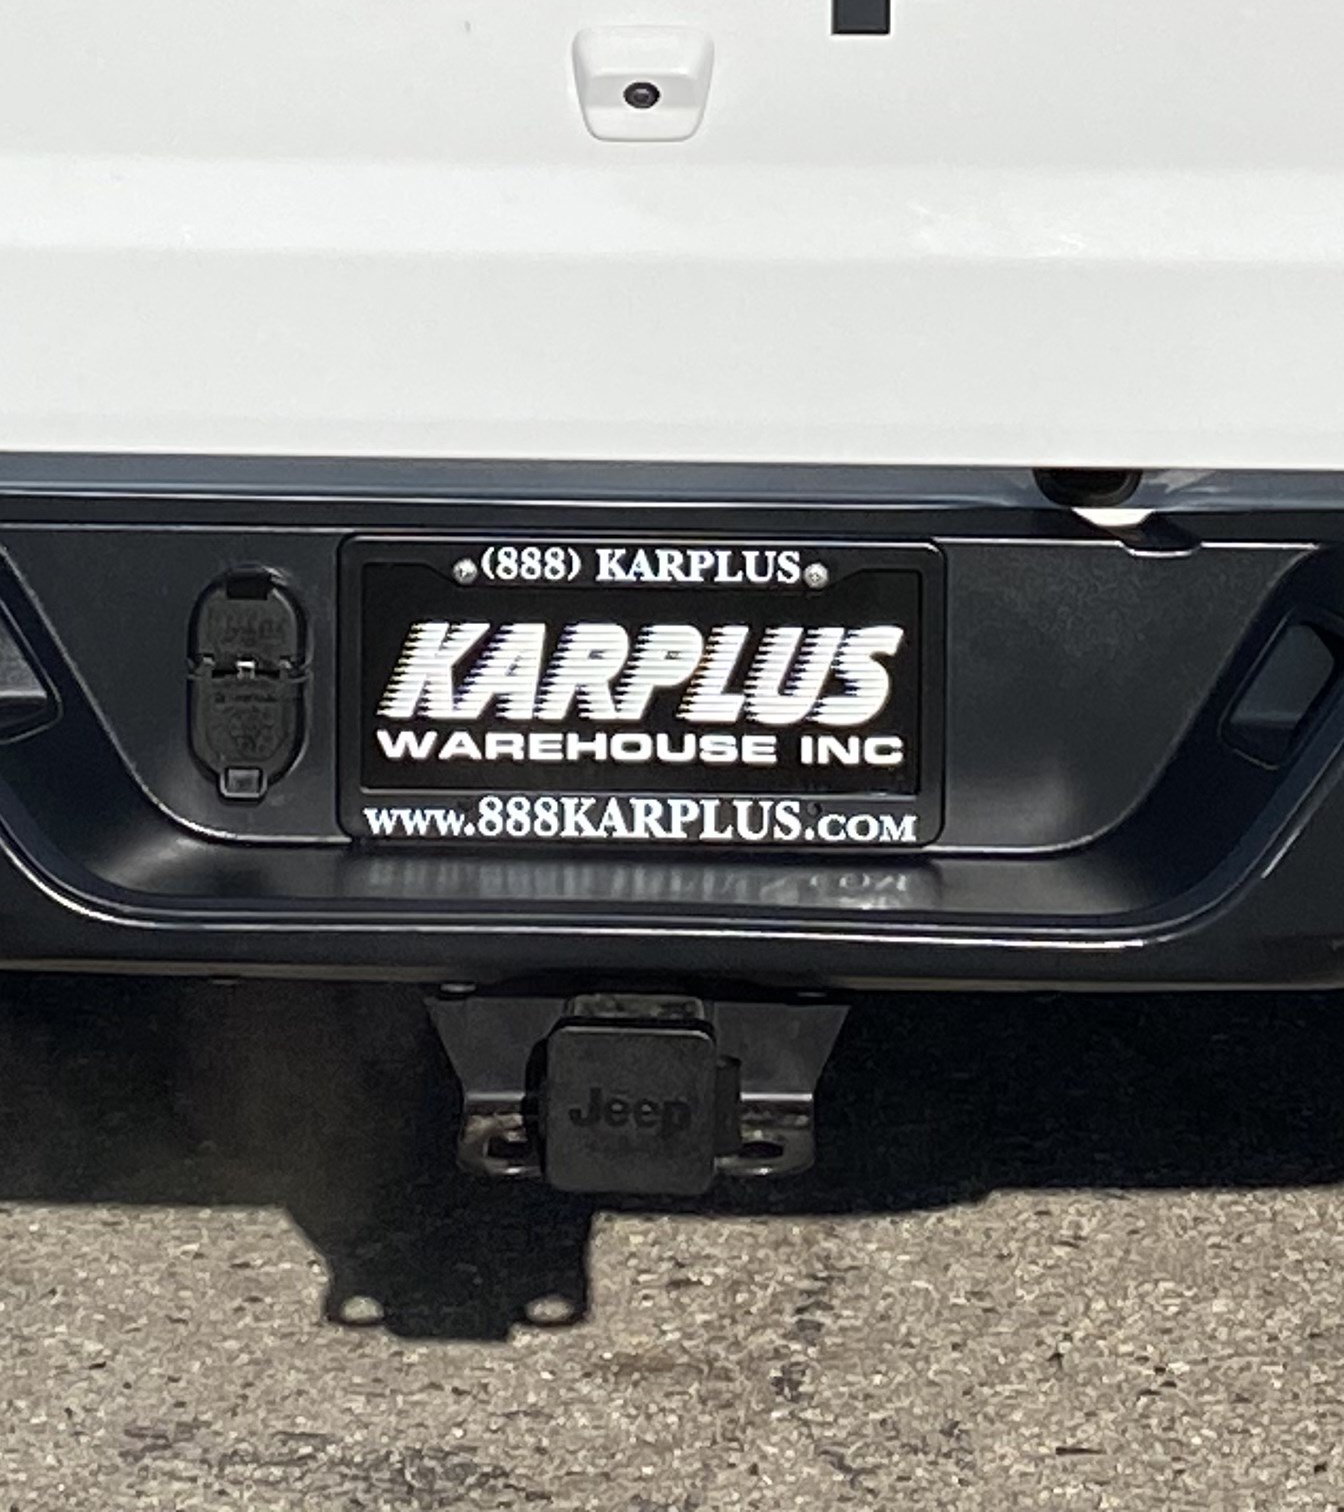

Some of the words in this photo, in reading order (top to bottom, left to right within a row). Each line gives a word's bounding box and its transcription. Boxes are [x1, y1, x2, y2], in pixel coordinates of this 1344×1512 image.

[481, 547, 581, 585] (888)
[595, 549, 801, 585] KARPLUS
[376, 621, 904, 726] KARPLUS
[376, 730, 777, 765] WAREHOUSE
[801, 735, 904, 766] INC
[568, 1087, 693, 1140] Jeep
